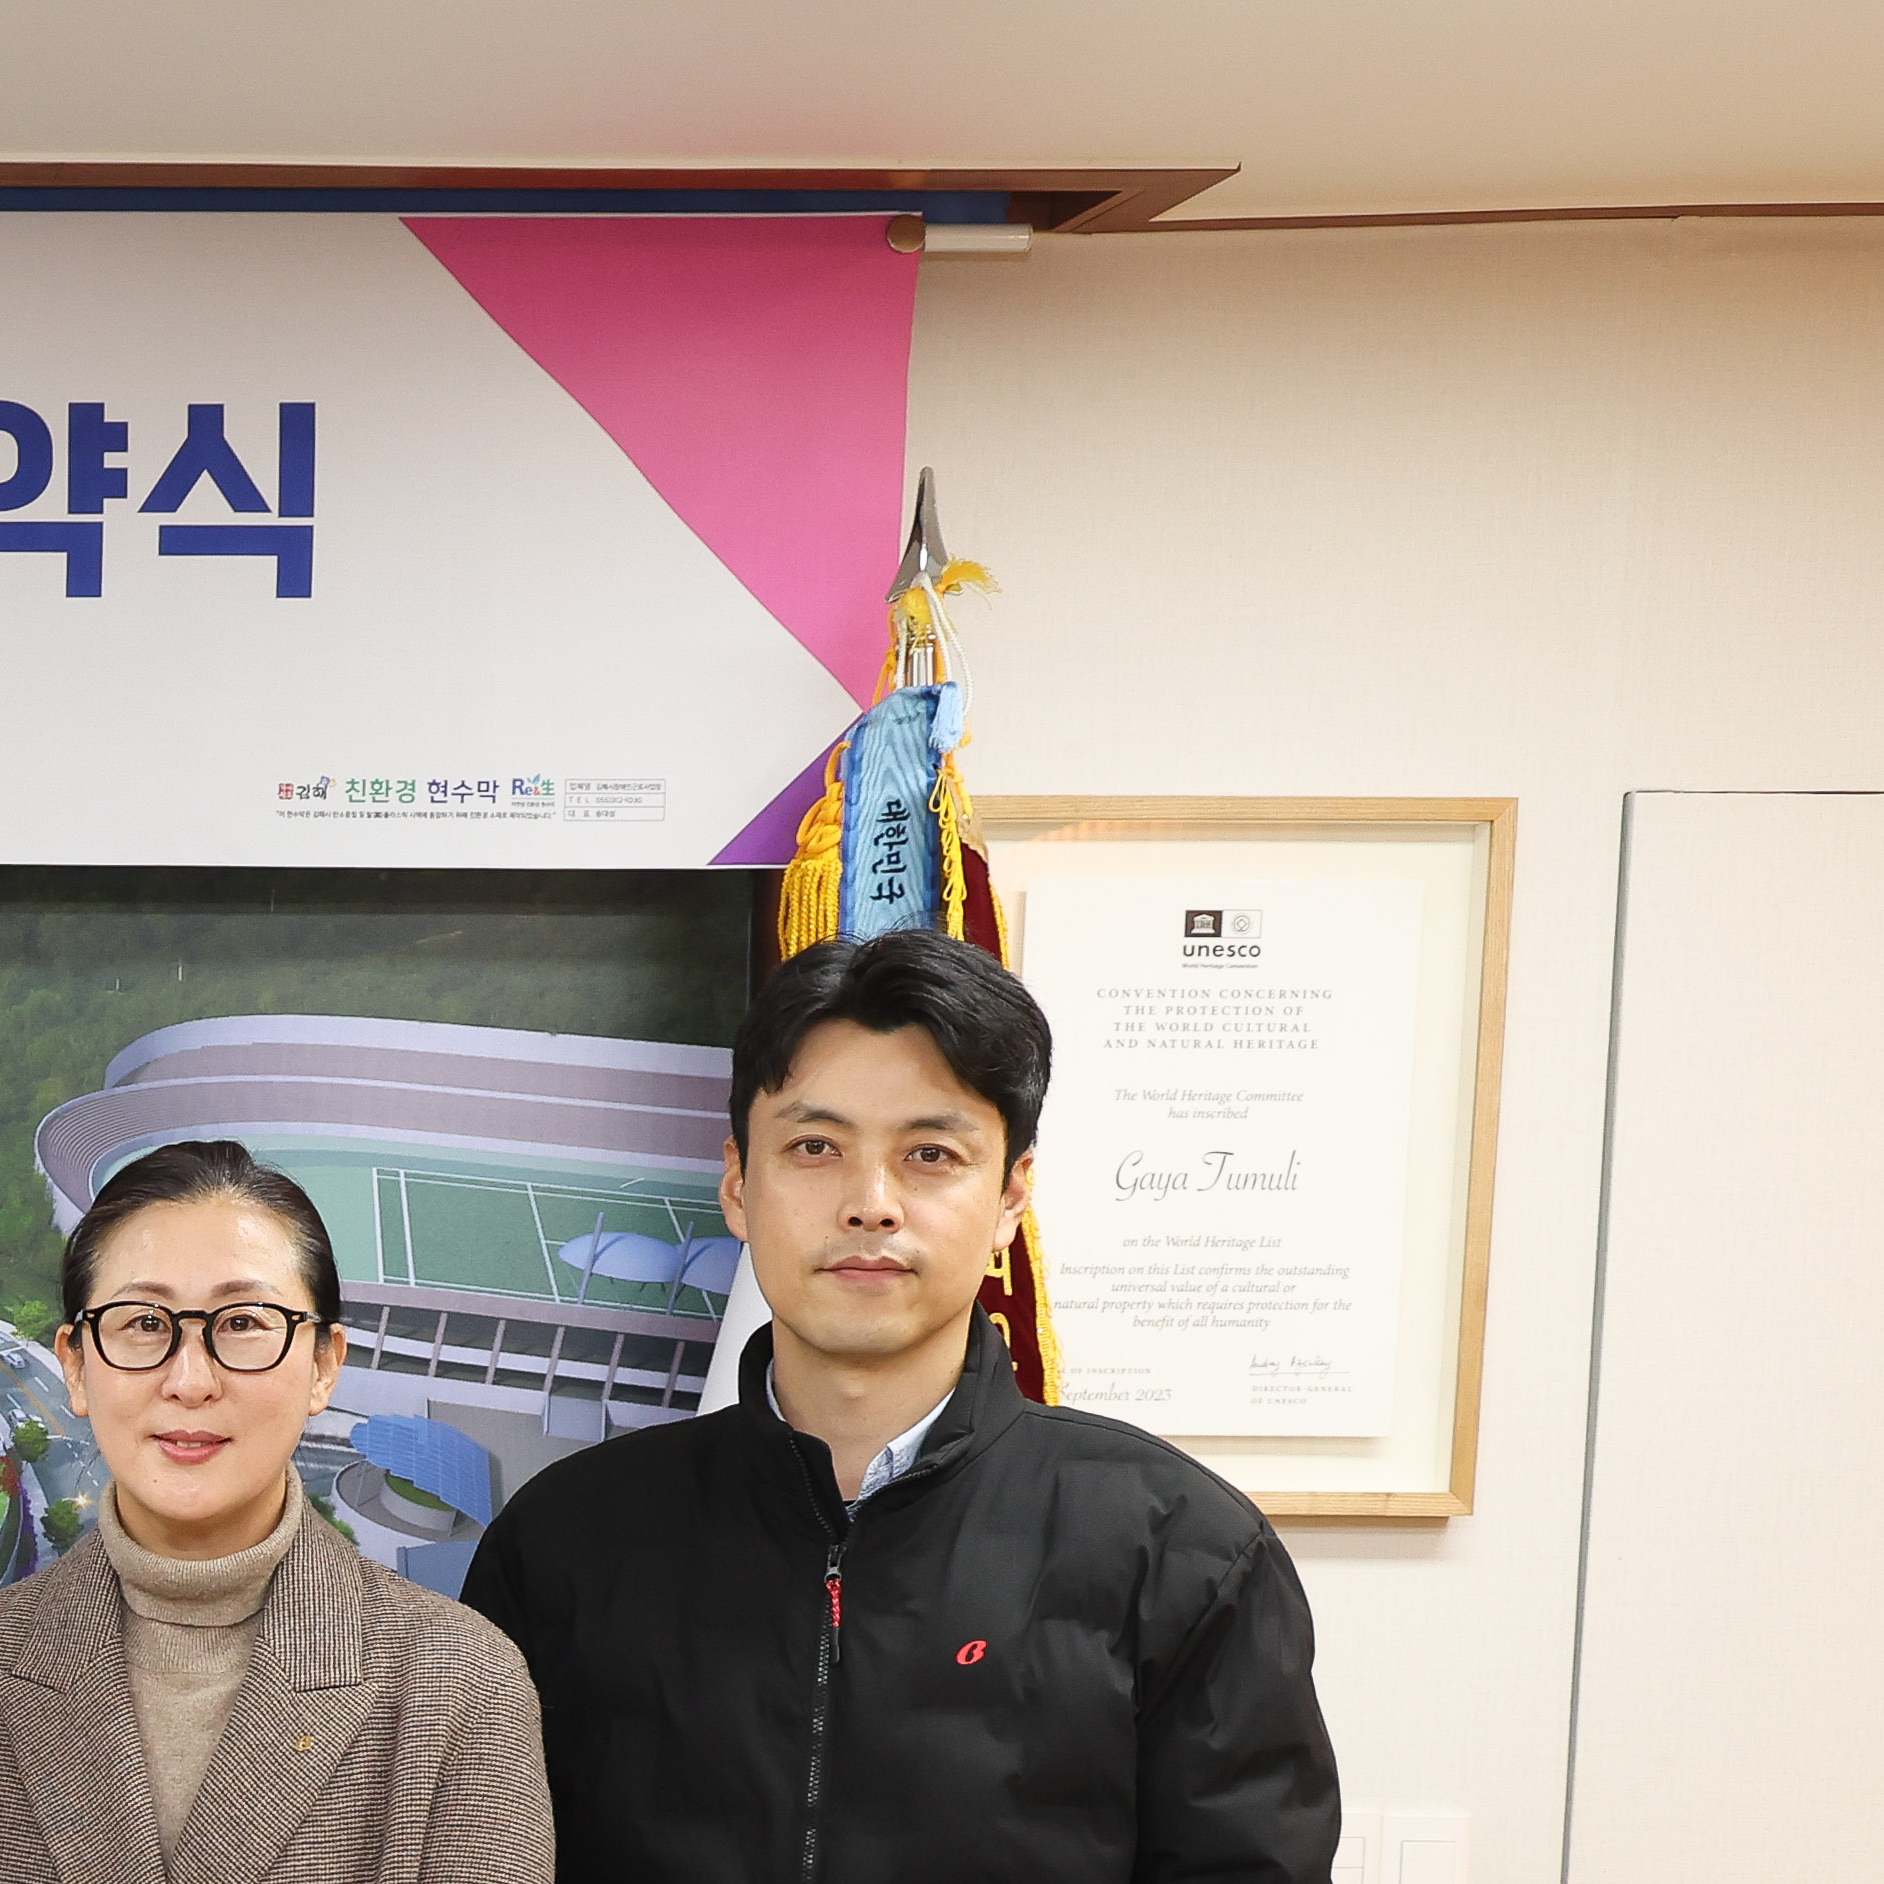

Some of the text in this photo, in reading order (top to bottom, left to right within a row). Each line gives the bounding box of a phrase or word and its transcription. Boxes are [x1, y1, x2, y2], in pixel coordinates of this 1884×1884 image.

[345, 779, 500, 804] 친환경 현수막
[870, 799, 911, 904] 대한민국
[1183, 945, 1261, 958] unesco
[1097, 989, 1332, 999] CONVENTION CONCERNING
[1124, 1005, 1303, 1016] THE PROTECTION OF
[1113, 1022, 1310, 1033] THE WORLD CULTURAL
[1104, 1039, 1318, 1049] AND NATURAL HERITAGE
[1115, 1089, 1304, 1105] The World Heritage Committee
[1168, 1106, 1249, 1119] has inscribed
[1115, 1150, 1301, 1202] Gaya Tumuli
[1122, 1235, 1282, 1252] on the World Heritage List
[1060, 1263, 1350, 1280] Inscription on this List confirms the outstanding
[1111, 1280, 1297, 1296] universal value of a cultural or
[1053, 1297, 1352, 1314] natural property which requires protection for the
[1133, 1315, 1271, 1331] benefit of all humanity
[1134, 1389, 1172, 1402] 2023
